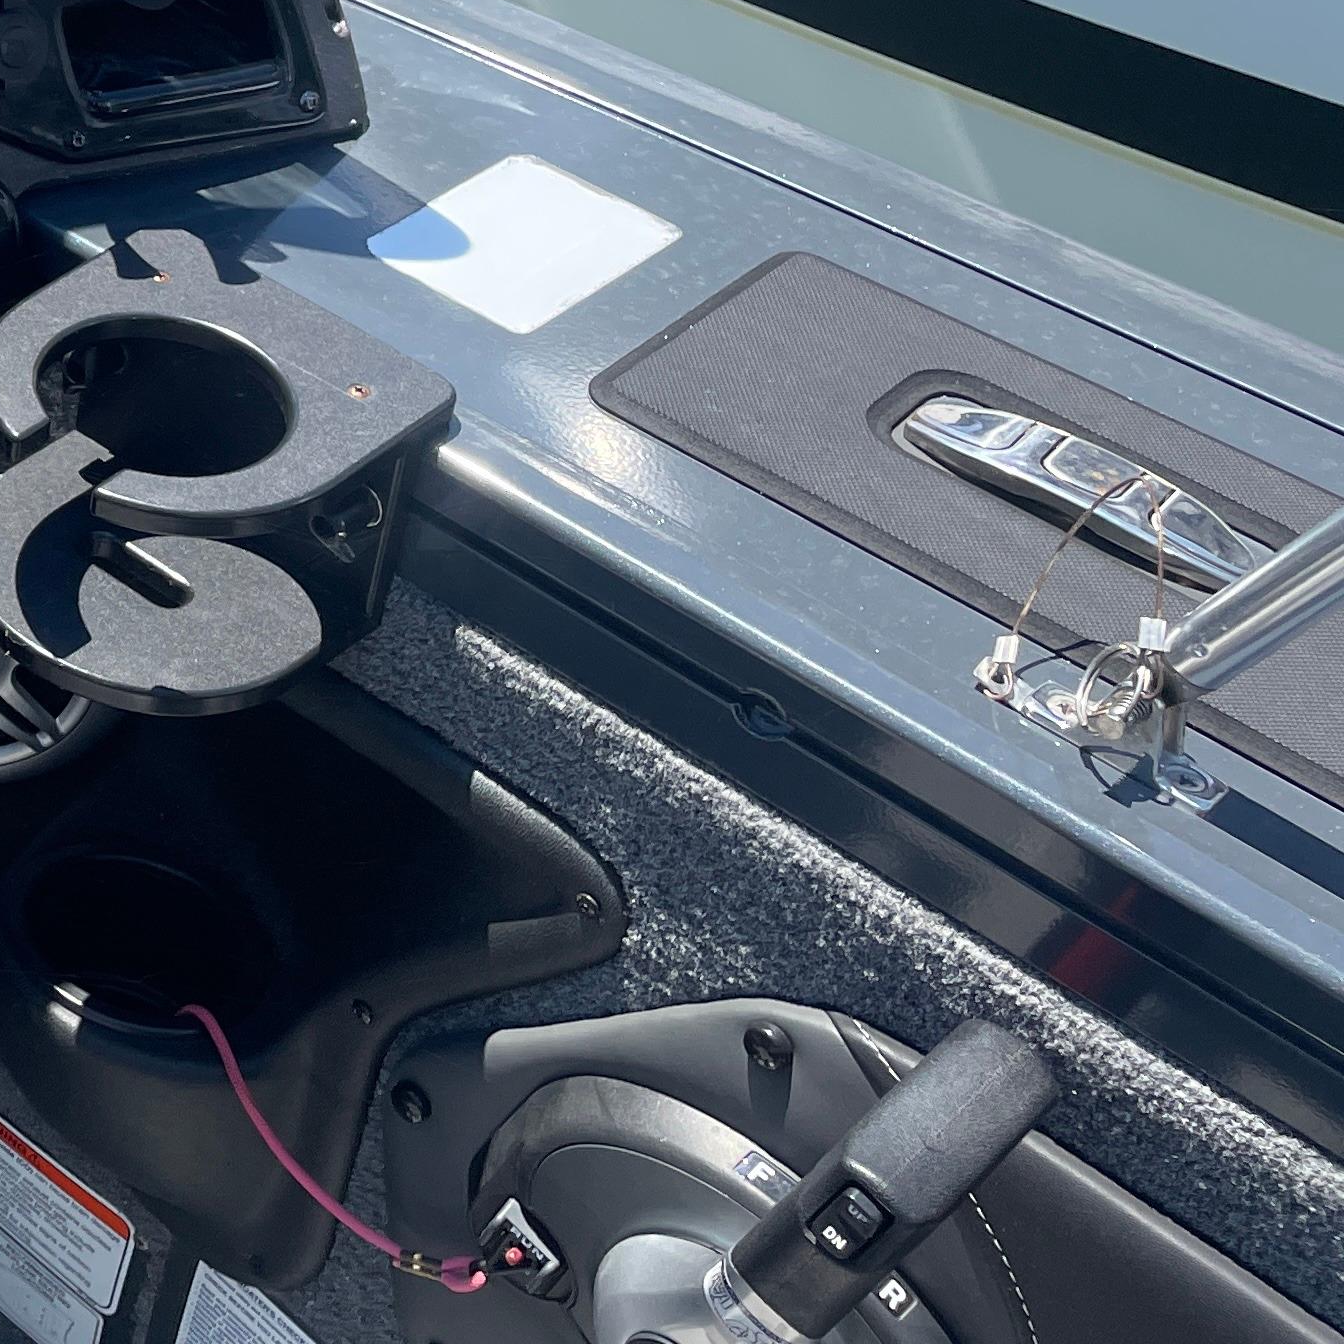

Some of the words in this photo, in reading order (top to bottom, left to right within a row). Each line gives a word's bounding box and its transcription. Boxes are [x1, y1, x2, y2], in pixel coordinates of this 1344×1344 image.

[746, 1160, 776, 1182] F
[822, 1225, 848, 1250] DN
[878, 1278, 907, 1310] R
